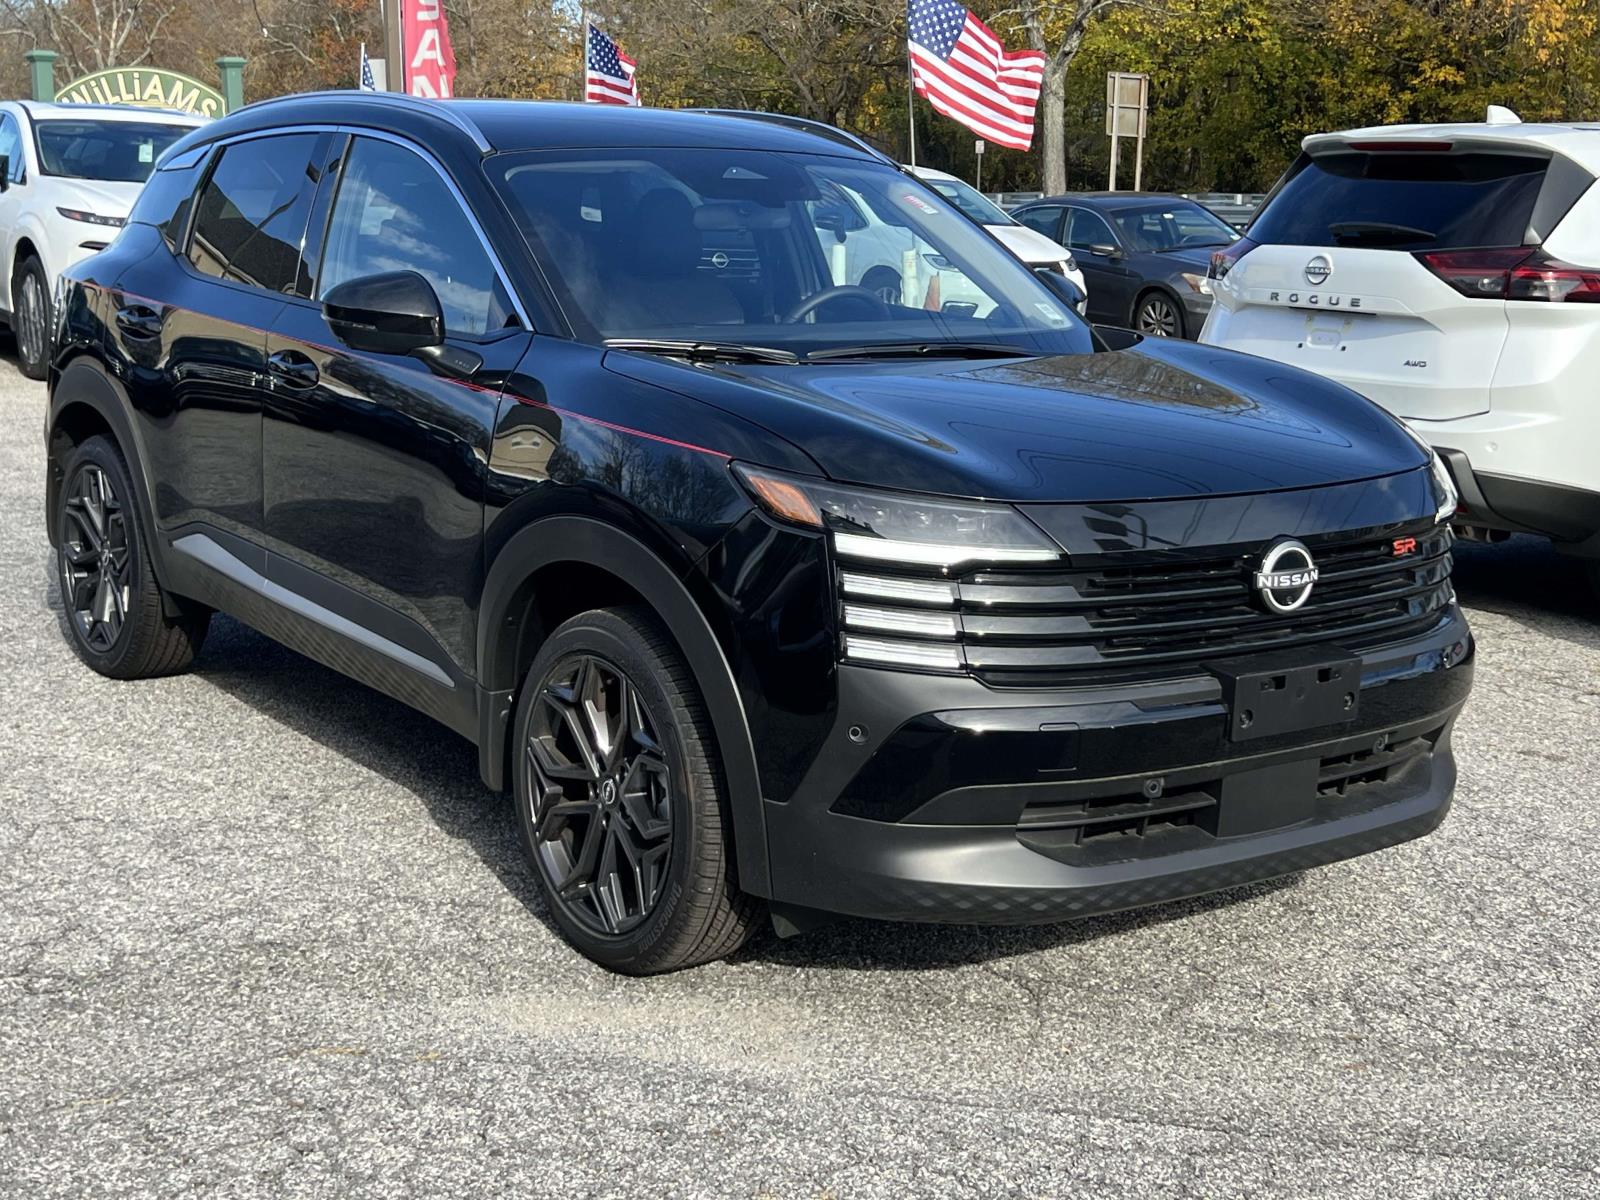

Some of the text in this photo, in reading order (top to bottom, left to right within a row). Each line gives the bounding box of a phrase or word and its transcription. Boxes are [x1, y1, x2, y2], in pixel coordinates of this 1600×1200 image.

[1270, 292, 1361, 307] ROGUE
[1392, 537, 1416, 556] SR
[1258, 569, 1318, 587] NISSAN
